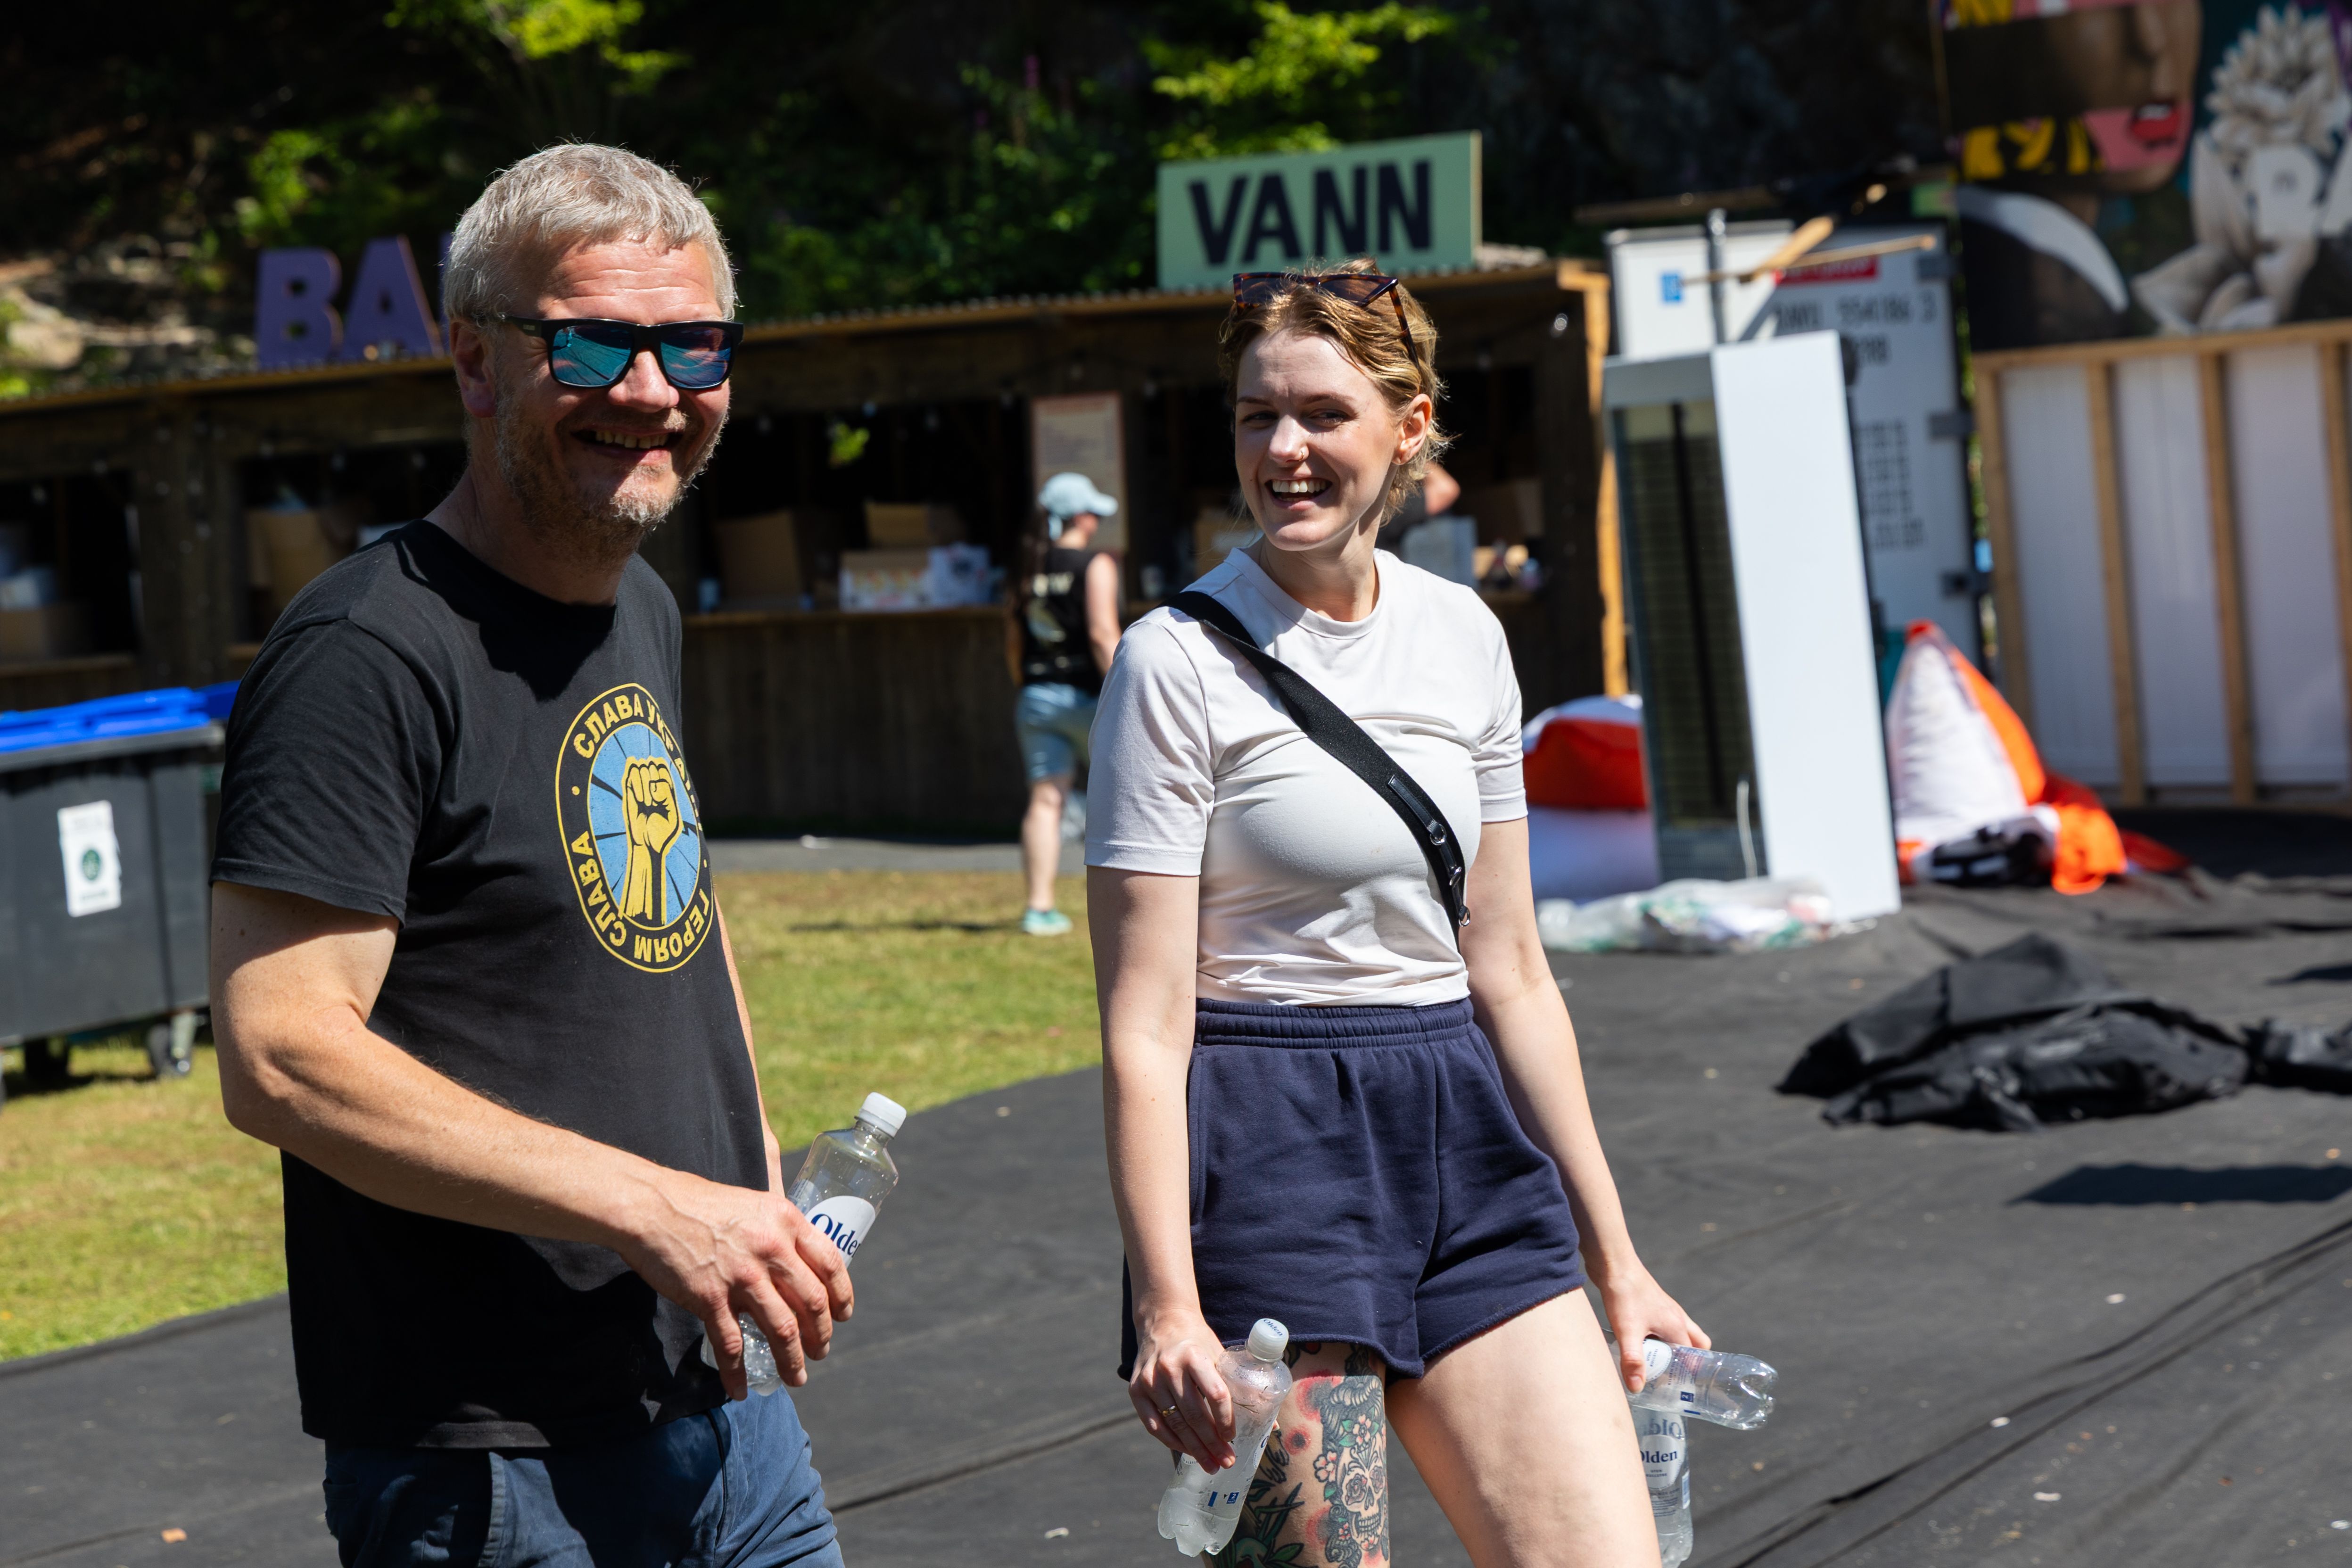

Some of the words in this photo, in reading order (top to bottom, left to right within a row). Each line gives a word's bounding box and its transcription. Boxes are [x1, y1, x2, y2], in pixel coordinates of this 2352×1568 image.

[1187, 159, 1432, 267] VANN
[255, 231, 455, 371] BA
[574, 693, 644, 759] СЛАВА
[571, 830, 627, 947] СЛАВА
[634, 888, 710, 963] ГЕРОЯМ
[1263, 1319, 1283, 1336] Olden
